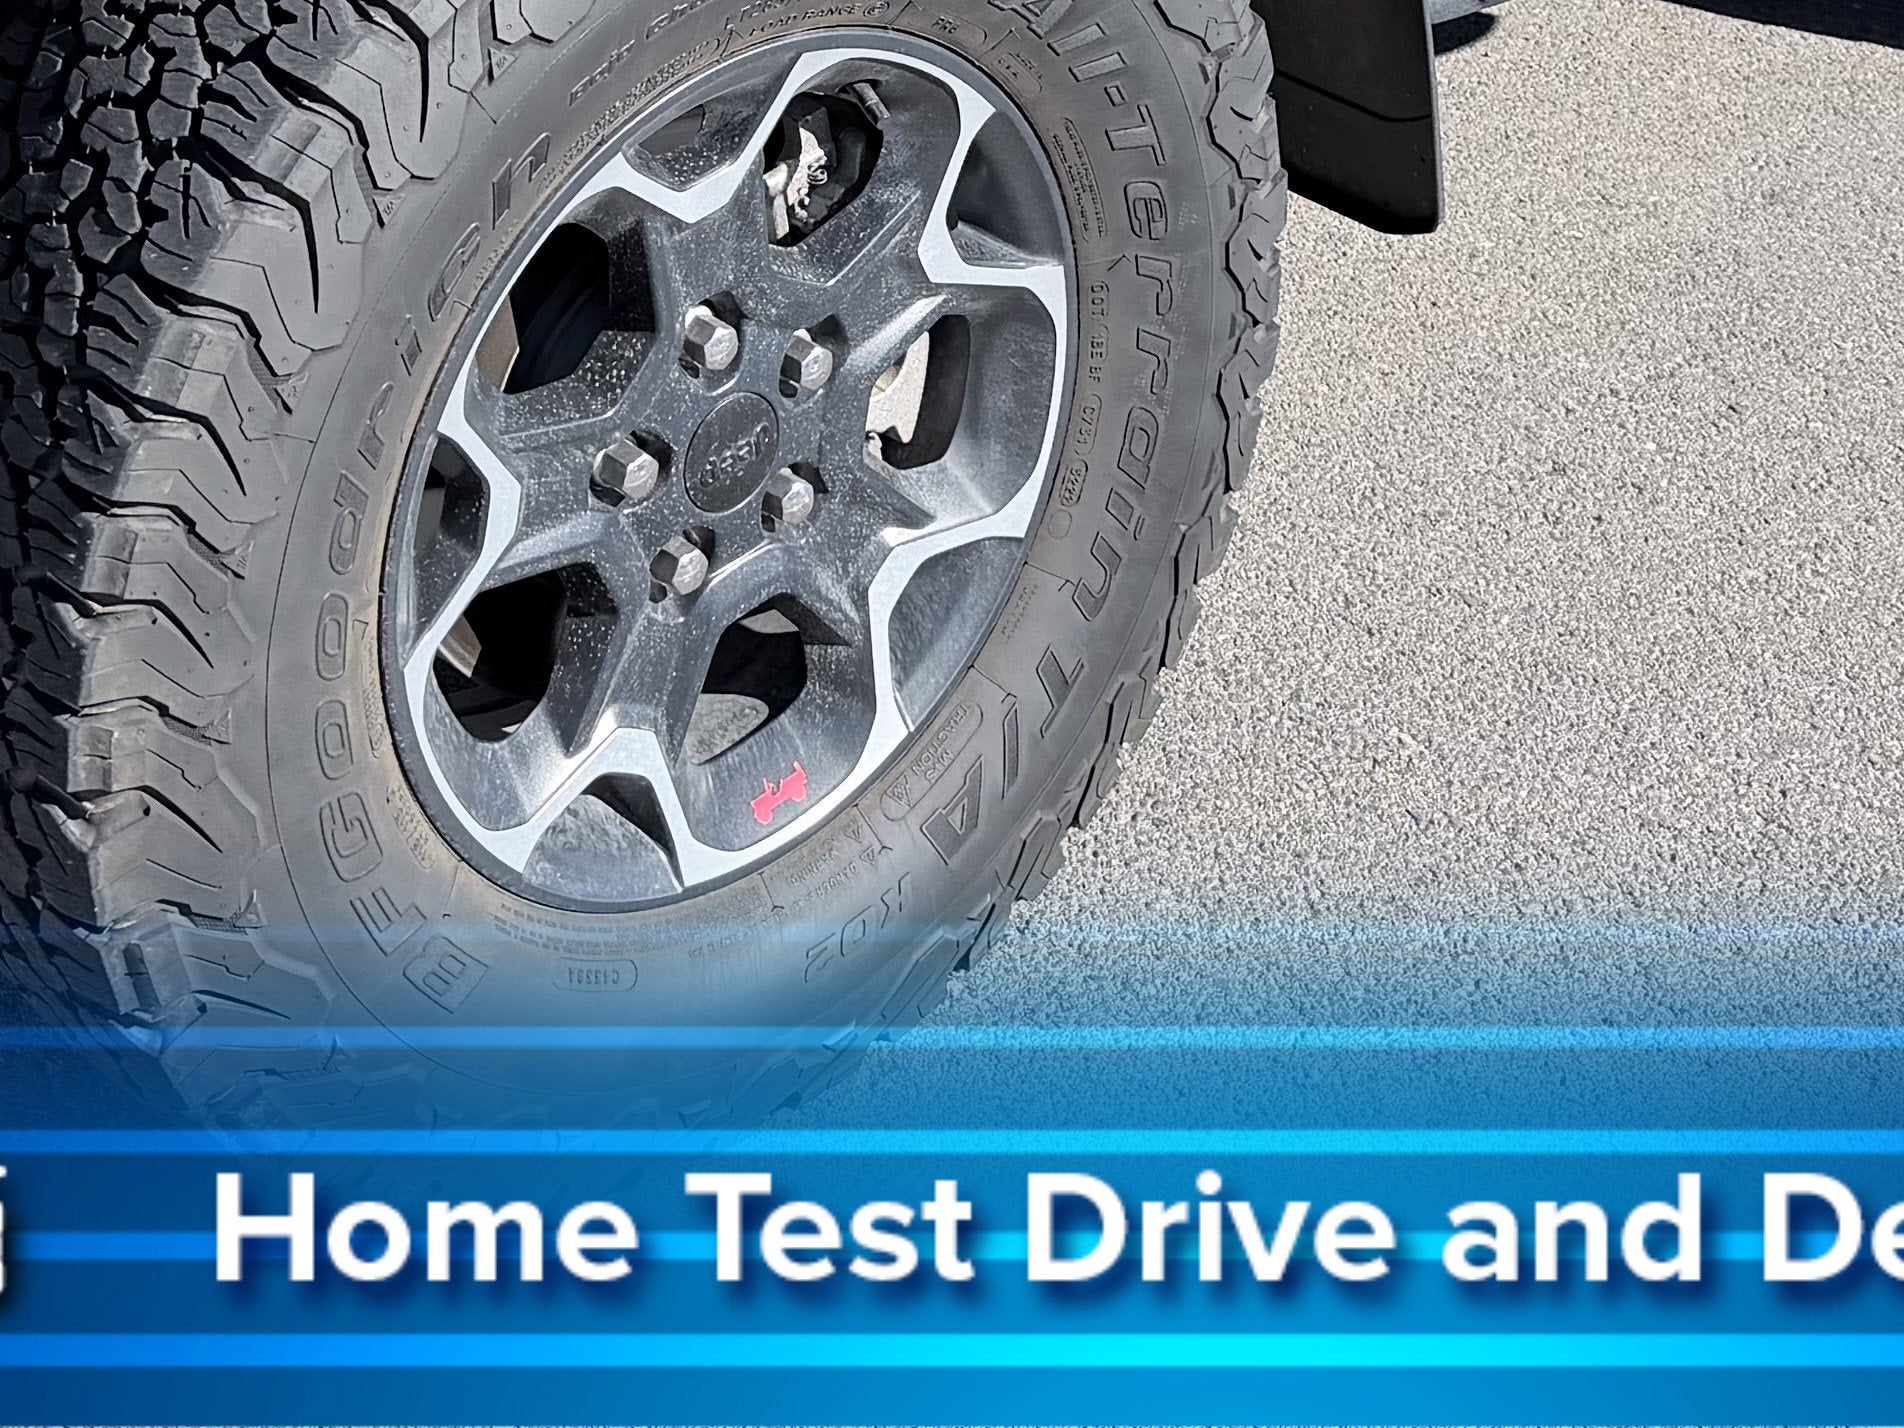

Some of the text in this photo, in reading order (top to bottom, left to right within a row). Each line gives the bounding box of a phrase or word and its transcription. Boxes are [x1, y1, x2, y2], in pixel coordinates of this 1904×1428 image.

[1090, 282, 1106, 319] DOT
[313, 128, 554, 1016] BFGoodrich
[911, 701, 969, 774] TRACTION
[920, 643, 1086, 866] T/A
